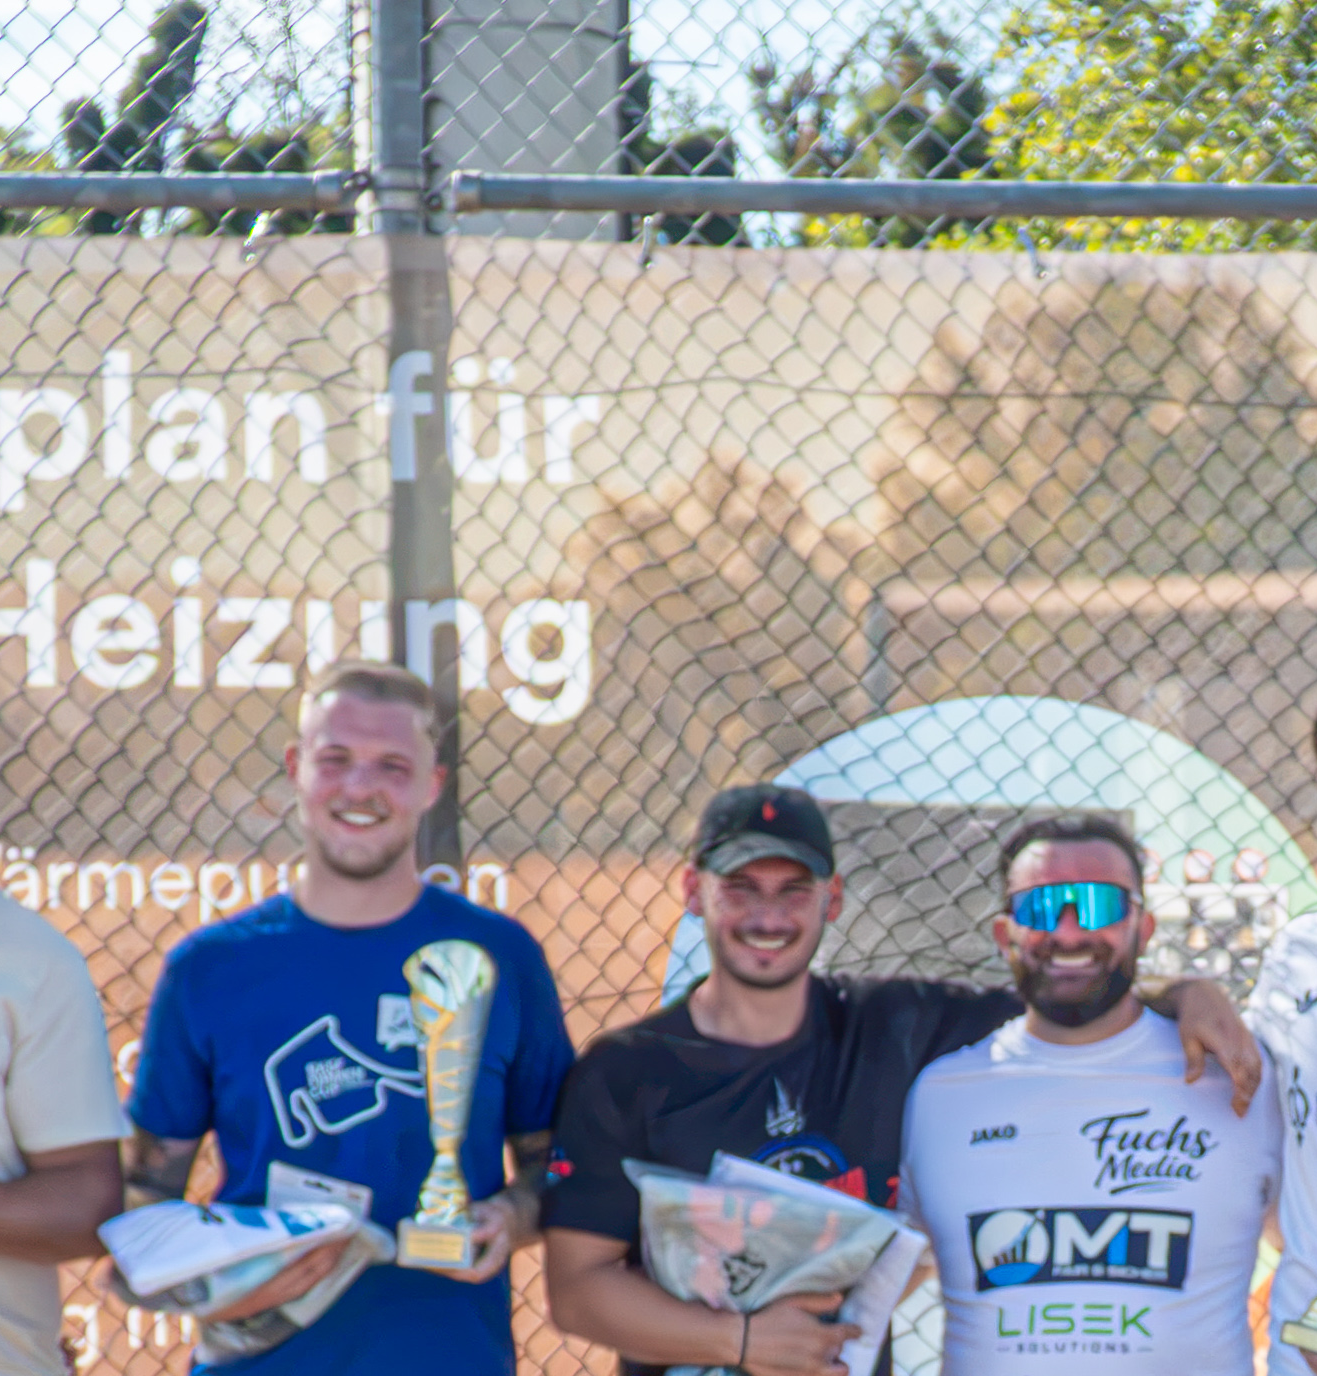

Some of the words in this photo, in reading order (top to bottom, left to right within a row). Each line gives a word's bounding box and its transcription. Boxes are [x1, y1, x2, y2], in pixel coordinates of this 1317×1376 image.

[376, 351, 599, 484] für
[1080, 1108, 1219, 1159] Fuchs
[1094, 1153, 1201, 1187] Media
[997, 1303, 1153, 1338] LISEK
[1016, 1342, 1131, 1354] SOLUTIONS
